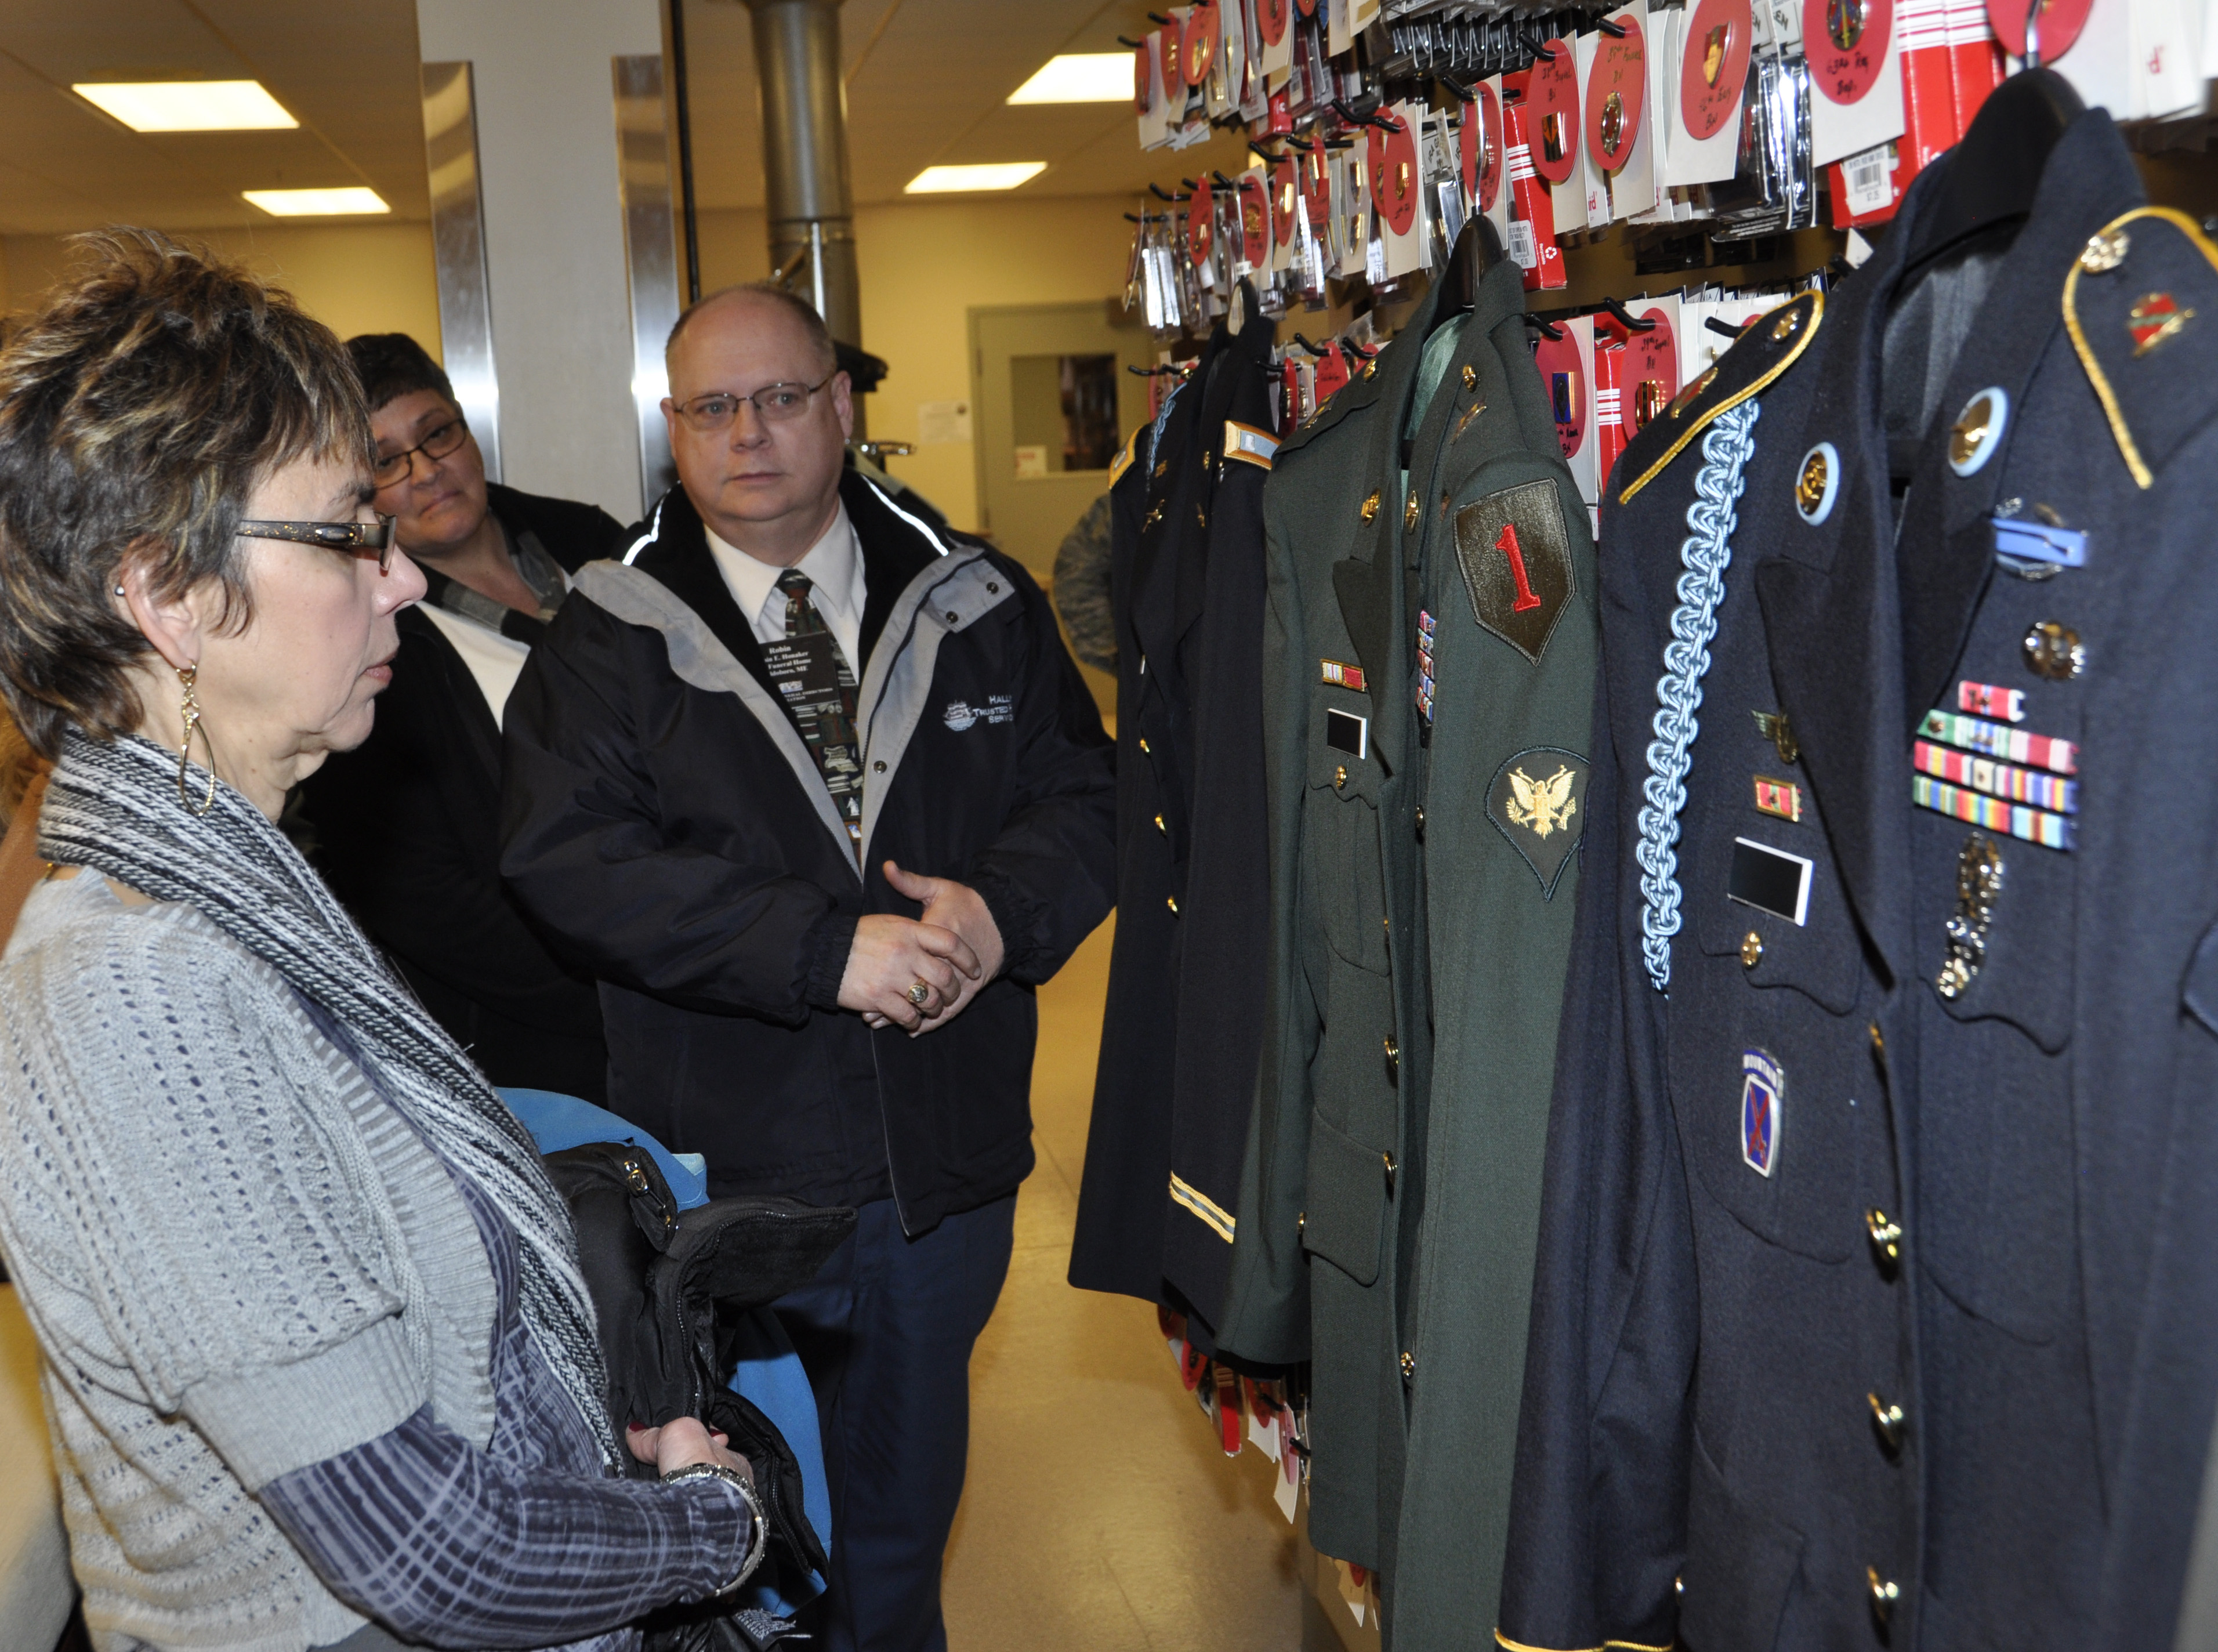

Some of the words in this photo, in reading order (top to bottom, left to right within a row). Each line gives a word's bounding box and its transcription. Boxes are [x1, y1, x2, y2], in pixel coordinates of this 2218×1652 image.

[1495, 523, 1541, 613] 1
[769, 646, 791, 654] Robin
[768, 661, 792, 669] Funeral
